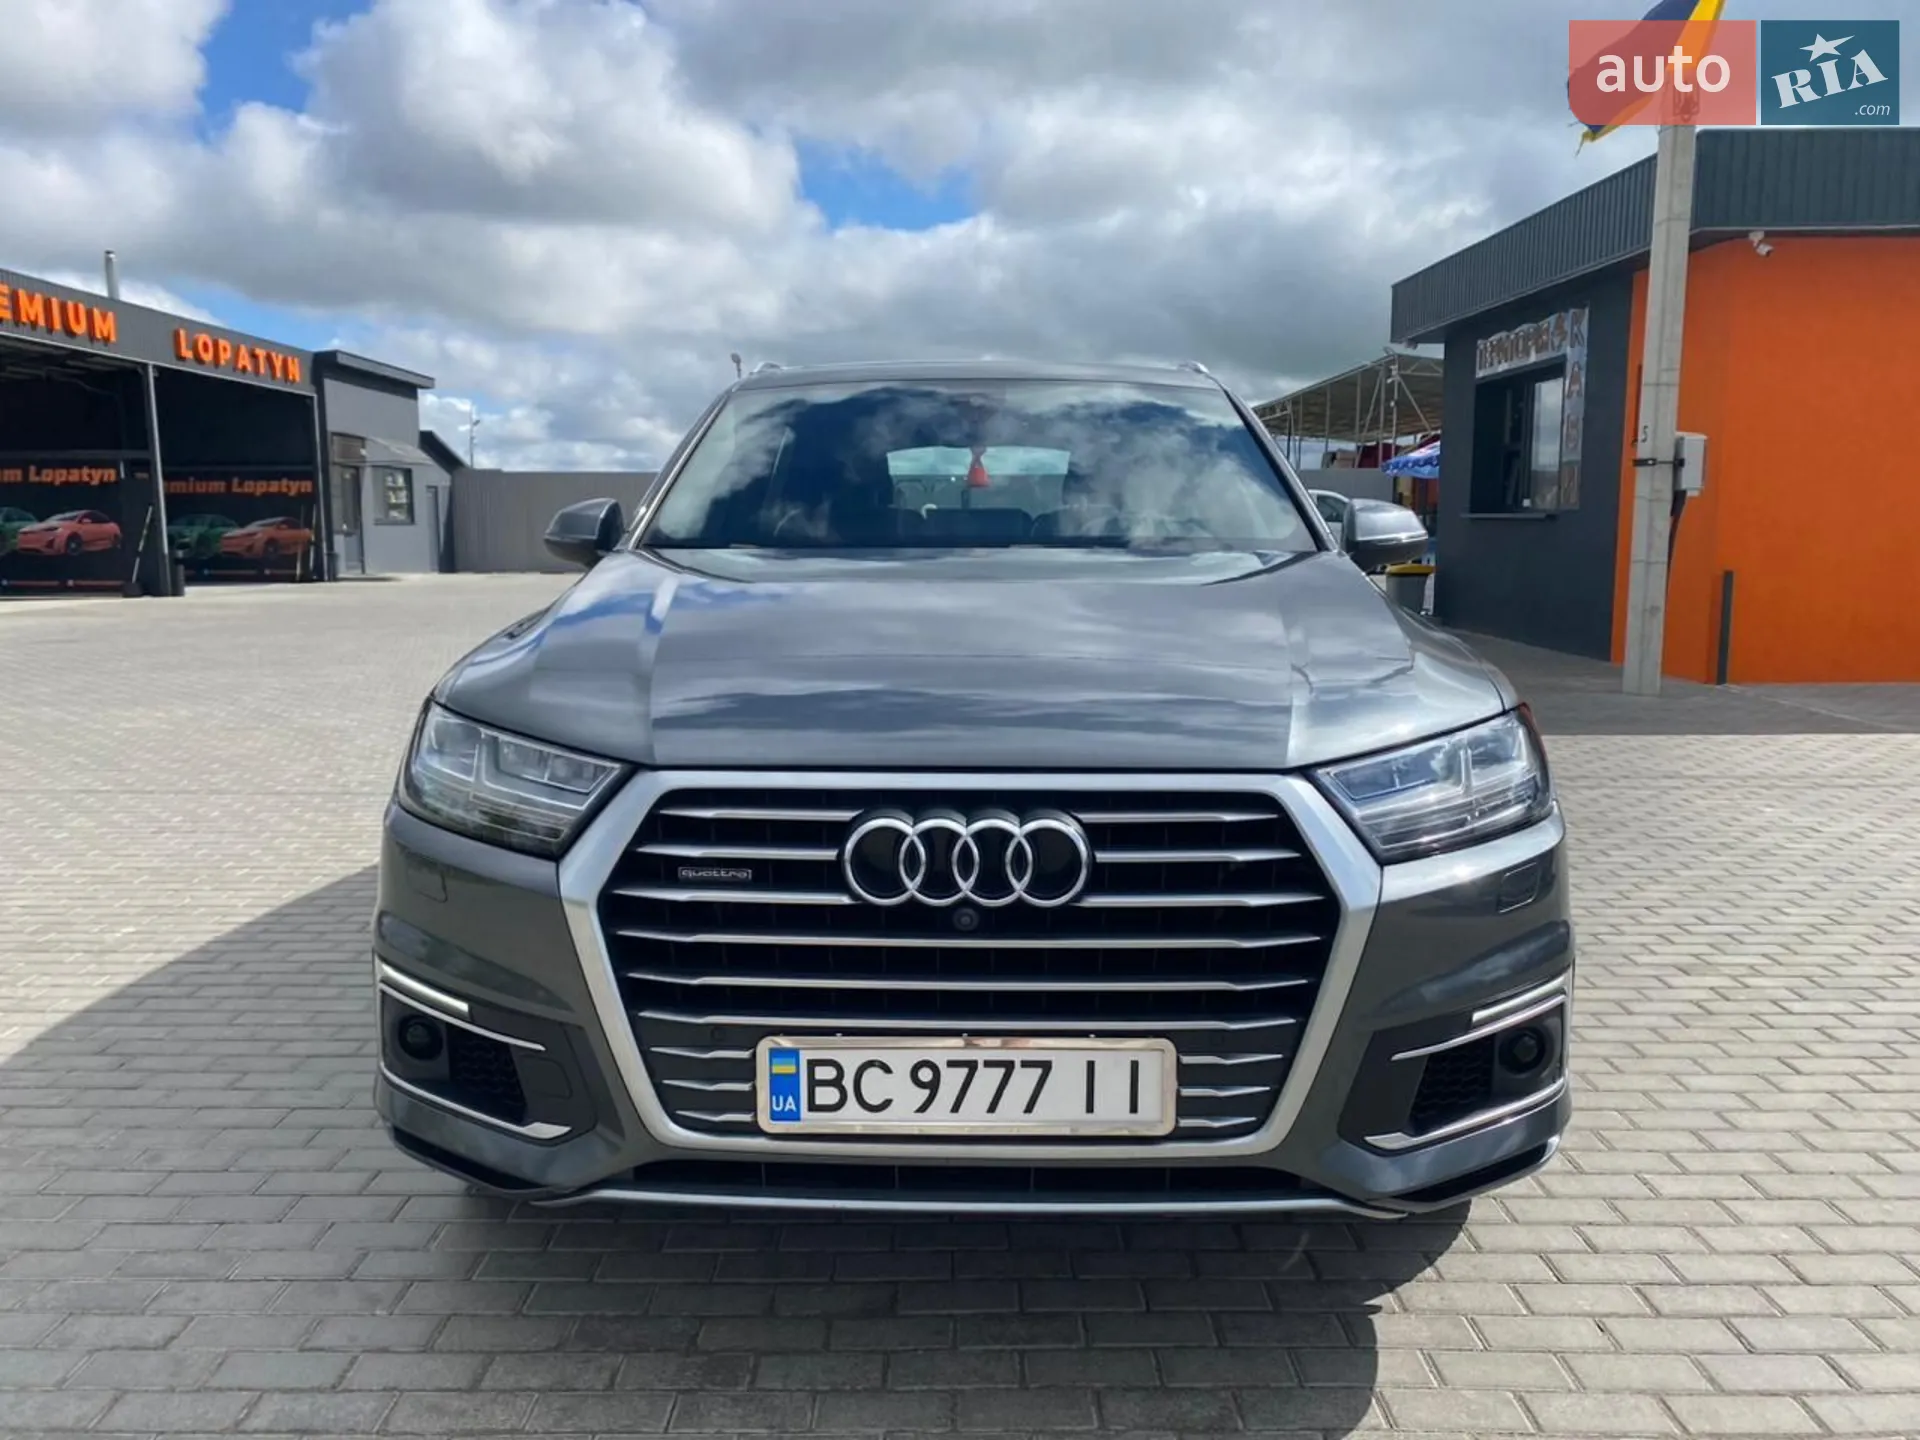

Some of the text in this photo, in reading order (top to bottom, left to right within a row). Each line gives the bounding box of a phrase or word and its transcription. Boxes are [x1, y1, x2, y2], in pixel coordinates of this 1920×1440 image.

[174, 327, 301, 384] LOPATYN
[28, 465, 118, 486] Lopatyn
[231, 477, 313, 497] Lopatyn
[681, 868, 749, 879] quattro
[805, 1058, 894, 1114] BC
[908, 1059, 1053, 1114] 9777
[771, 1095, 797, 1113] UA
